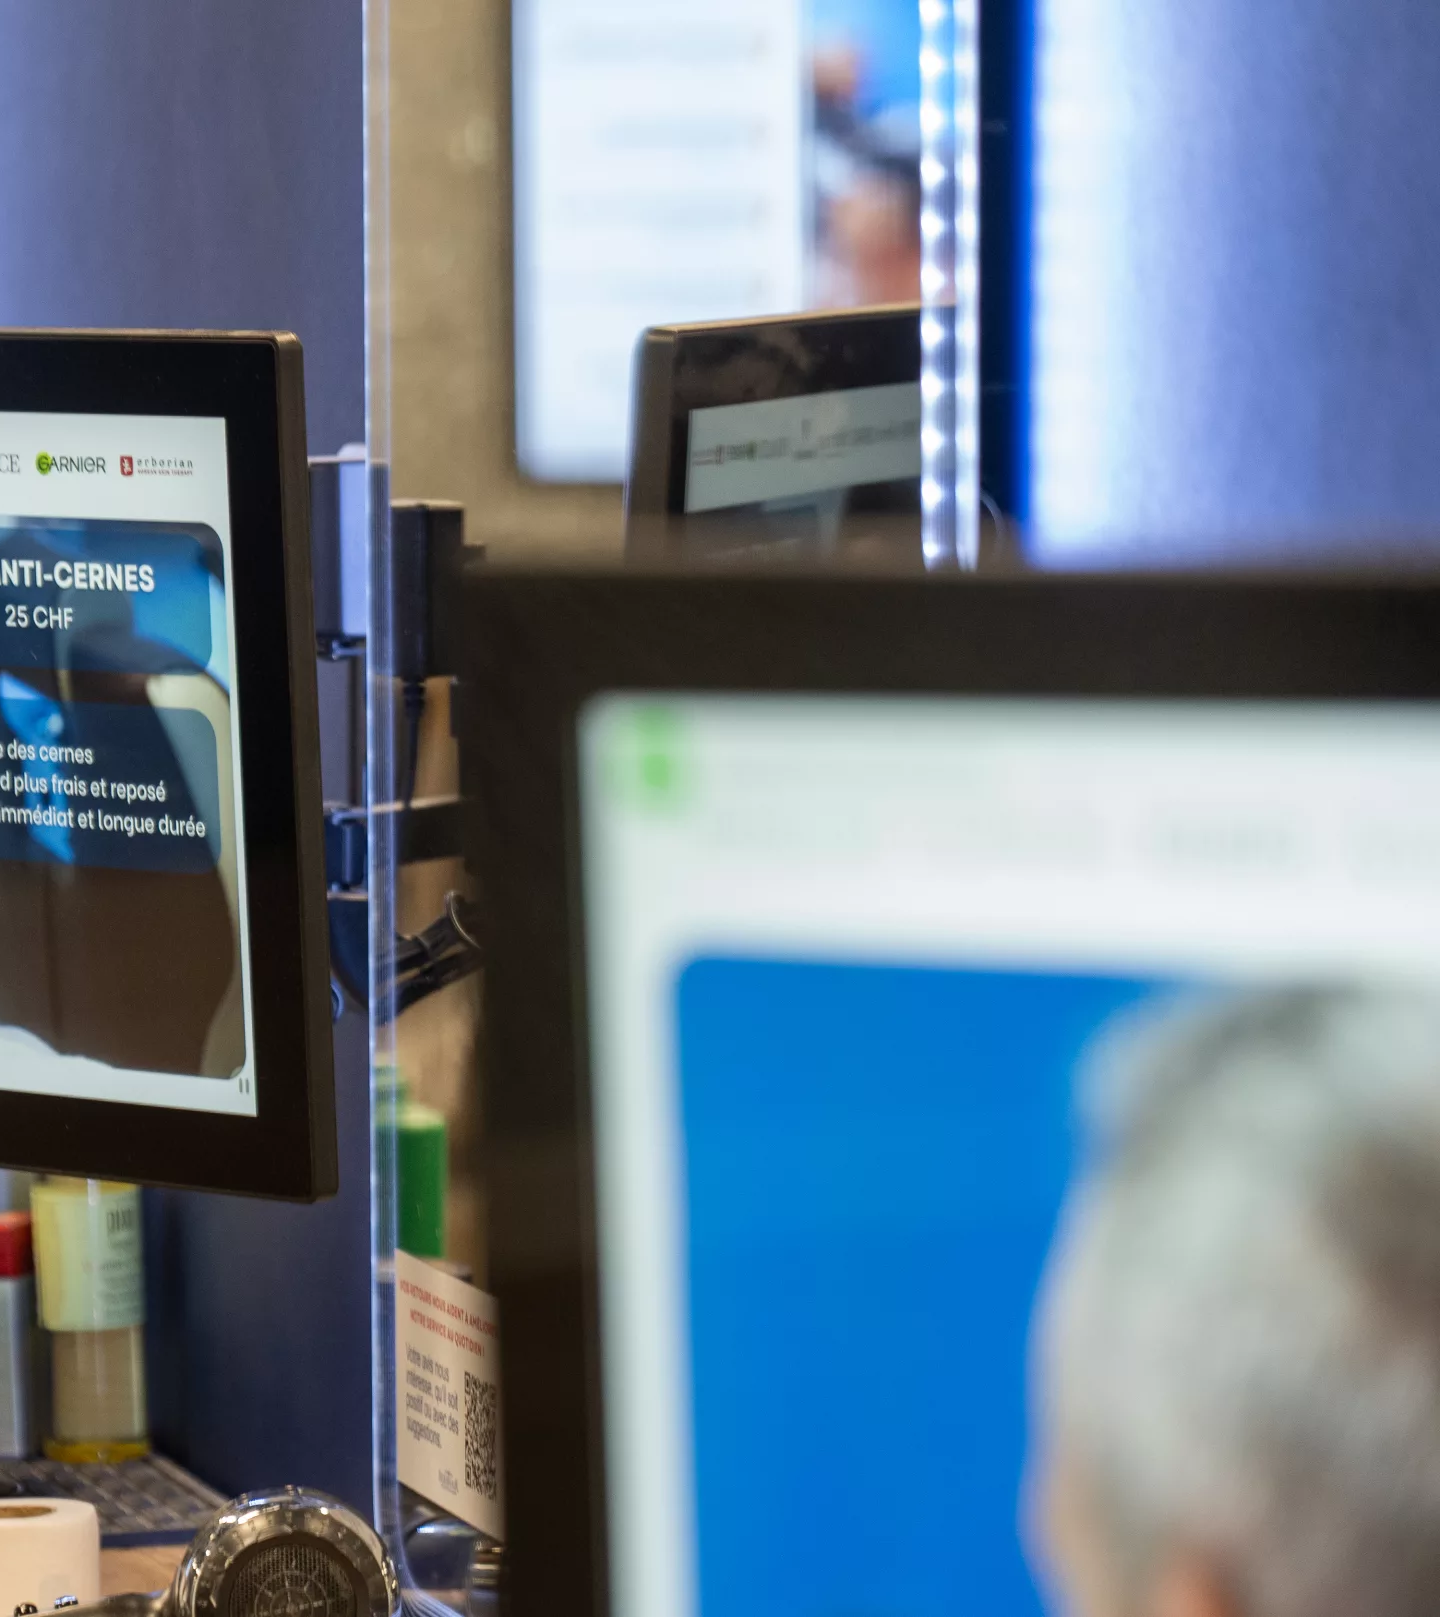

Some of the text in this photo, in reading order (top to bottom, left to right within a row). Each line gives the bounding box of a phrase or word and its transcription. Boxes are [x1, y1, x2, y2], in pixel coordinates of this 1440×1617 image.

[37, 454, 106, 474] GARNIER
[136, 456, 194, 469] erborian
[5, 605, 74, 630] 25 CHF
[7, 741, 35, 761] des
[39, 746, 94, 765] cernes
[14, 771, 48, 796] plus
[52, 774, 86, 796] frais
[90, 778, 107, 797] et
[111, 780, 166, 804] reposé
[78, 810, 94, 828] et
[98, 810, 154, 837] longue
[158, 814, 206, 838] durée
[426, 1314, 447, 1338] SERVICE
[454, 1331, 482, 1356] QUOTIDIEN
[435, 1361, 449, 1382] nous
[433, 1407, 447, 1429] avec
[448, 1412, 459, 1436] des
